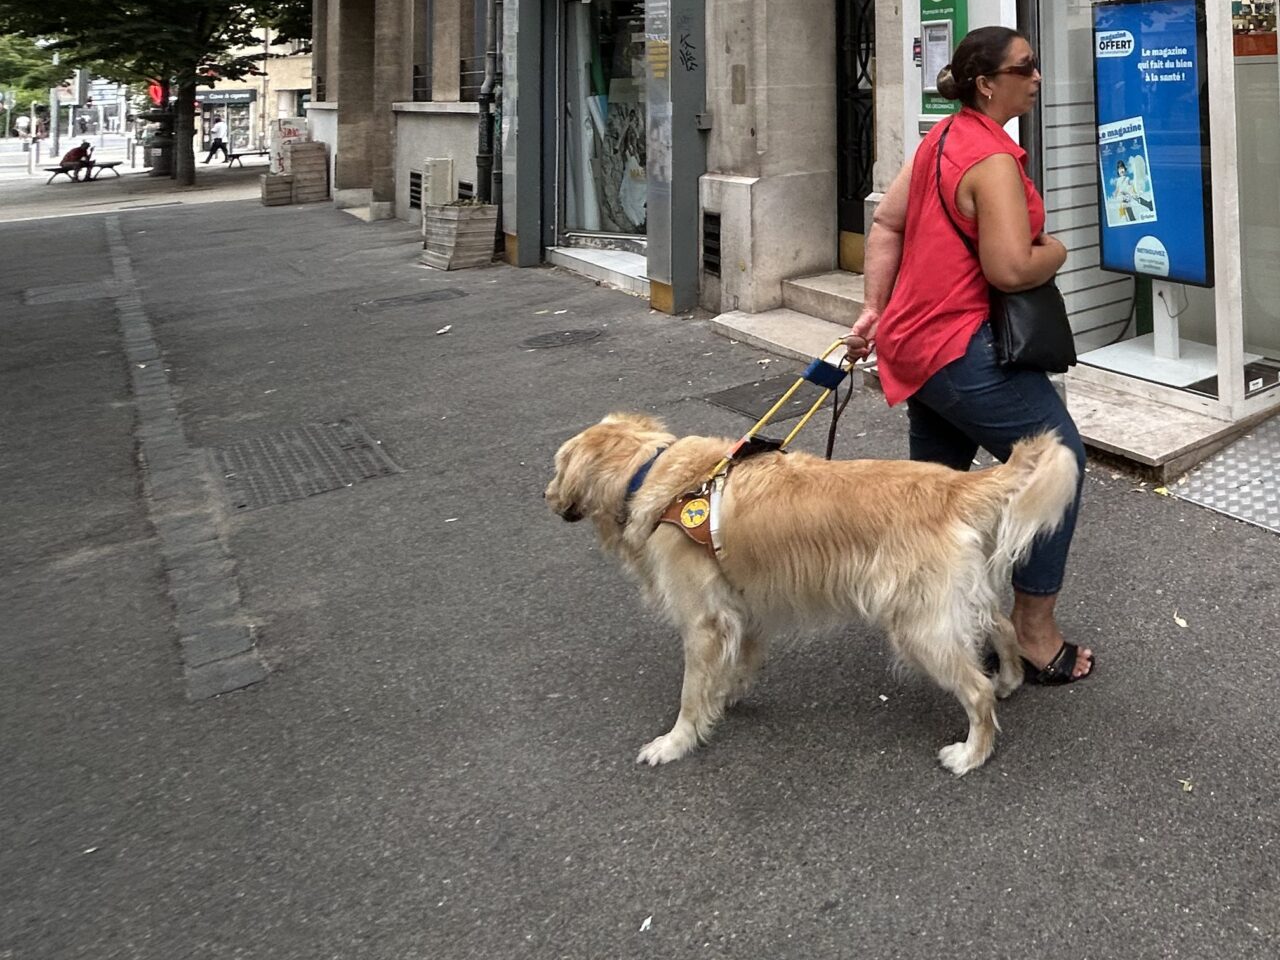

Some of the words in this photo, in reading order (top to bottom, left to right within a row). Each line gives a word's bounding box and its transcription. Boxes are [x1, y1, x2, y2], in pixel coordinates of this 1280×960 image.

[1099, 40, 1132, 51] OFFERT
[1141, 48, 1150, 56] Le
[1151, 46, 1187, 58] magazine
[1137, 60, 1149, 72] qui
[1150, 59, 1163, 69] fait
[1165, 59, 1175, 69] du
[1175, 58, 1193, 68] bien
[1144, 72, 1151, 82] à
[1151, 73, 1158, 82] la
[1159, 72, 1181, 82] santé
[1107, 123, 1142, 138] magazine
